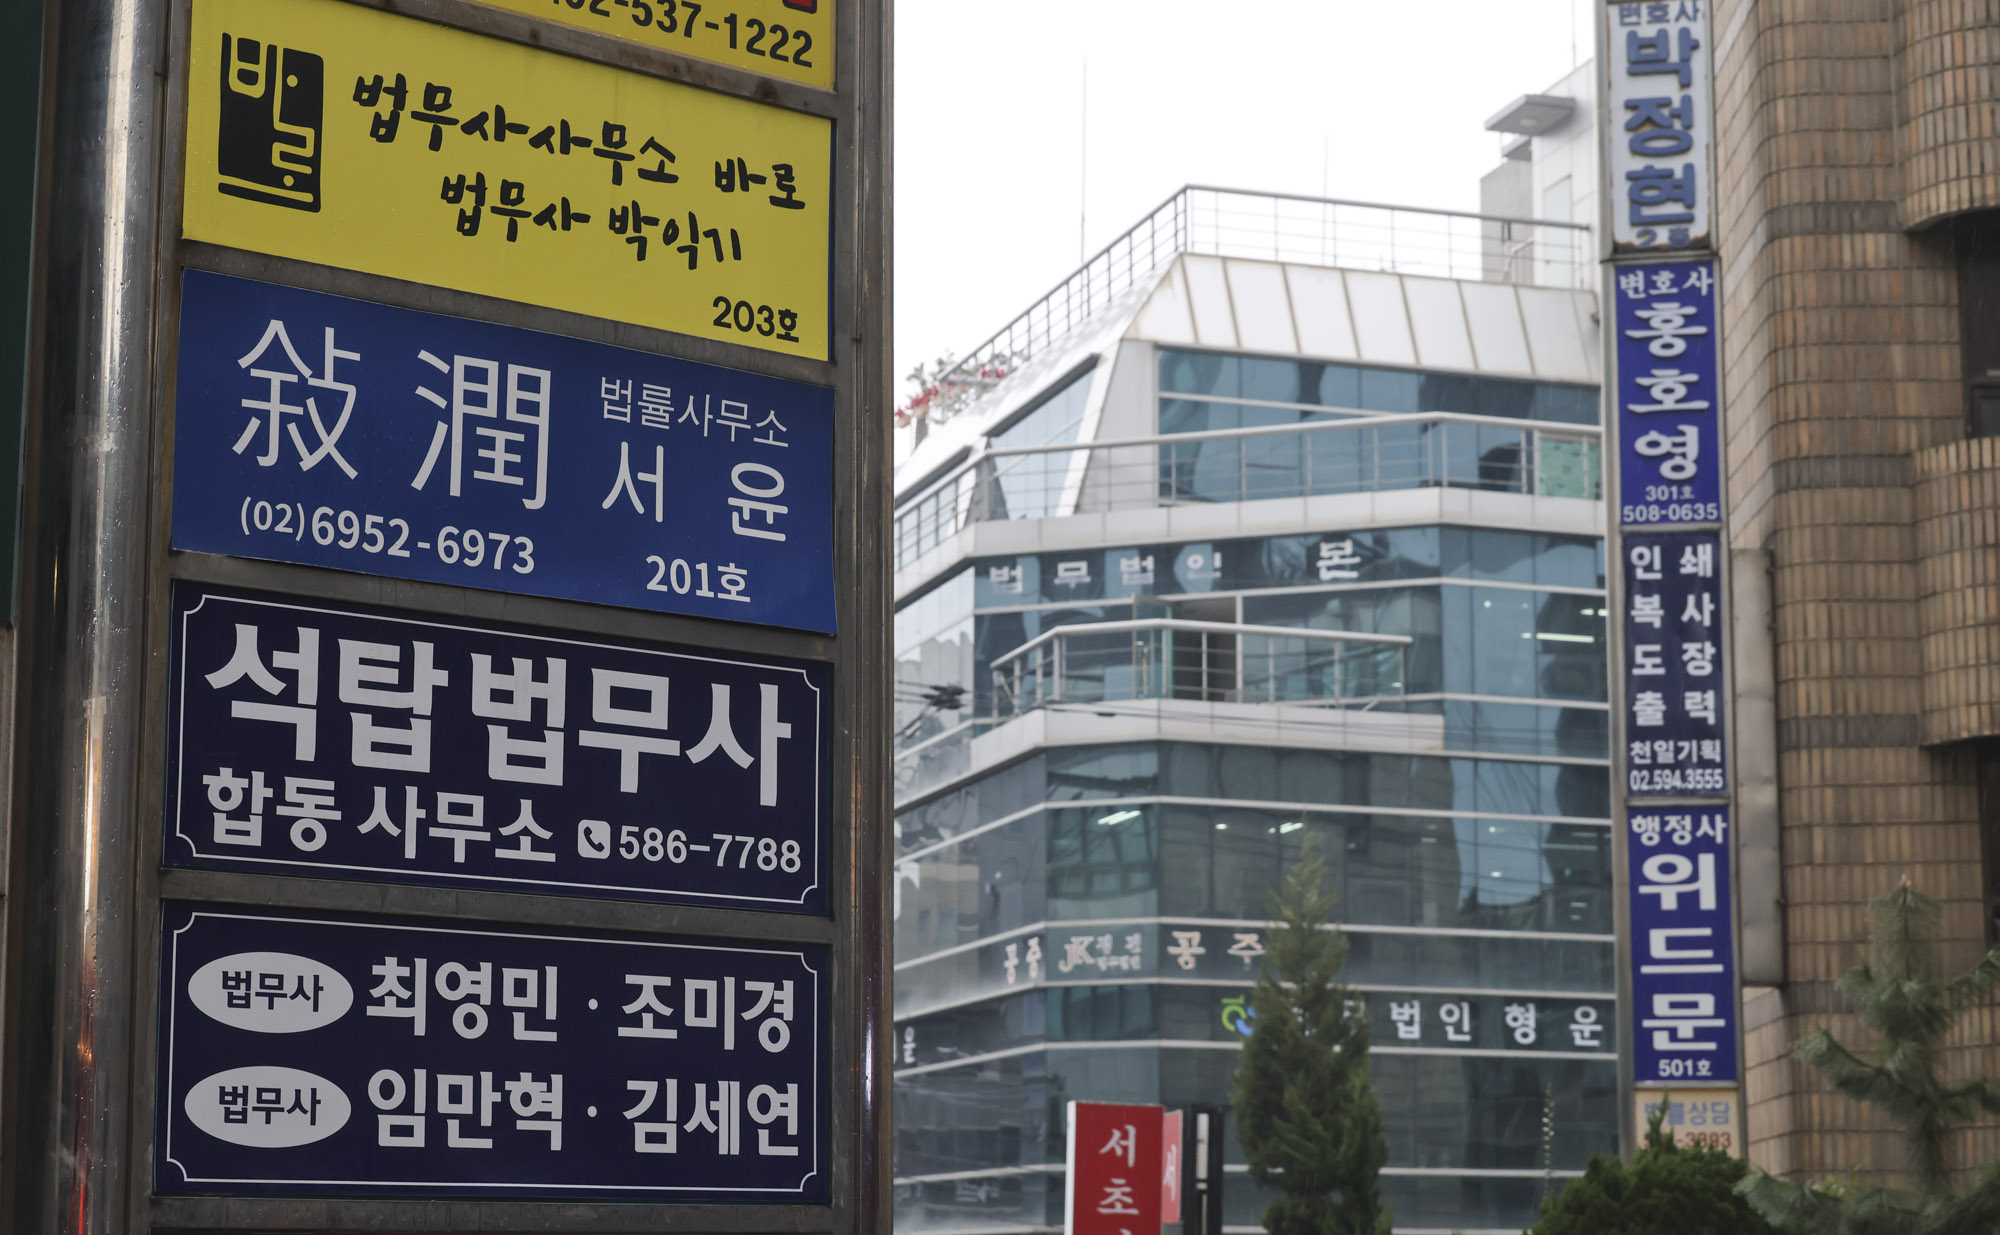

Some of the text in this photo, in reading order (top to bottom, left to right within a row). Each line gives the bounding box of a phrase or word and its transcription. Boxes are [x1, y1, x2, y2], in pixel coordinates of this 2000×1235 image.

[353, 73, 806, 210] 법무사사무소 바로
[1624, 27, 1700, 227] 박정현
[440, 172, 742, 270] 법무사 박익기
[1619, 266, 1713, 299] 변호사
[711, 295, 800, 344] 203호
[599, 375, 790, 448] 법률사무소
[1624, 302, 1710, 481] 홍호영
[1622, 502, 1718, 523] 508-0635
[1645, 484, 1695, 501] 301호
[240, 495, 536, 575] (02)6952-6973
[645, 554, 752, 604] 201호
[1630, 543, 1713, 580] 인쇄
[1630, 592, 1715, 629] 복사
[1631, 641, 1716, 676] 도장
[1632, 689, 1716, 727] 출력
[1630, 739, 1722, 764] 천일기획
[1630, 768, 1723, 791] 02.594.3555
[618, 825, 802, 873] 586-7788
[1630, 814, 1728, 847] 행정사
[1638, 853, 1726, 1051] 위드문
[221, 955, 796, 1053] 법무사 최영민 조미경
[1658, 1059, 1712, 1077] 501호
[217, 1067, 800, 1156] 법무사 임만혁 김세연
[1096, 1124, 1140, 1235] 서초
